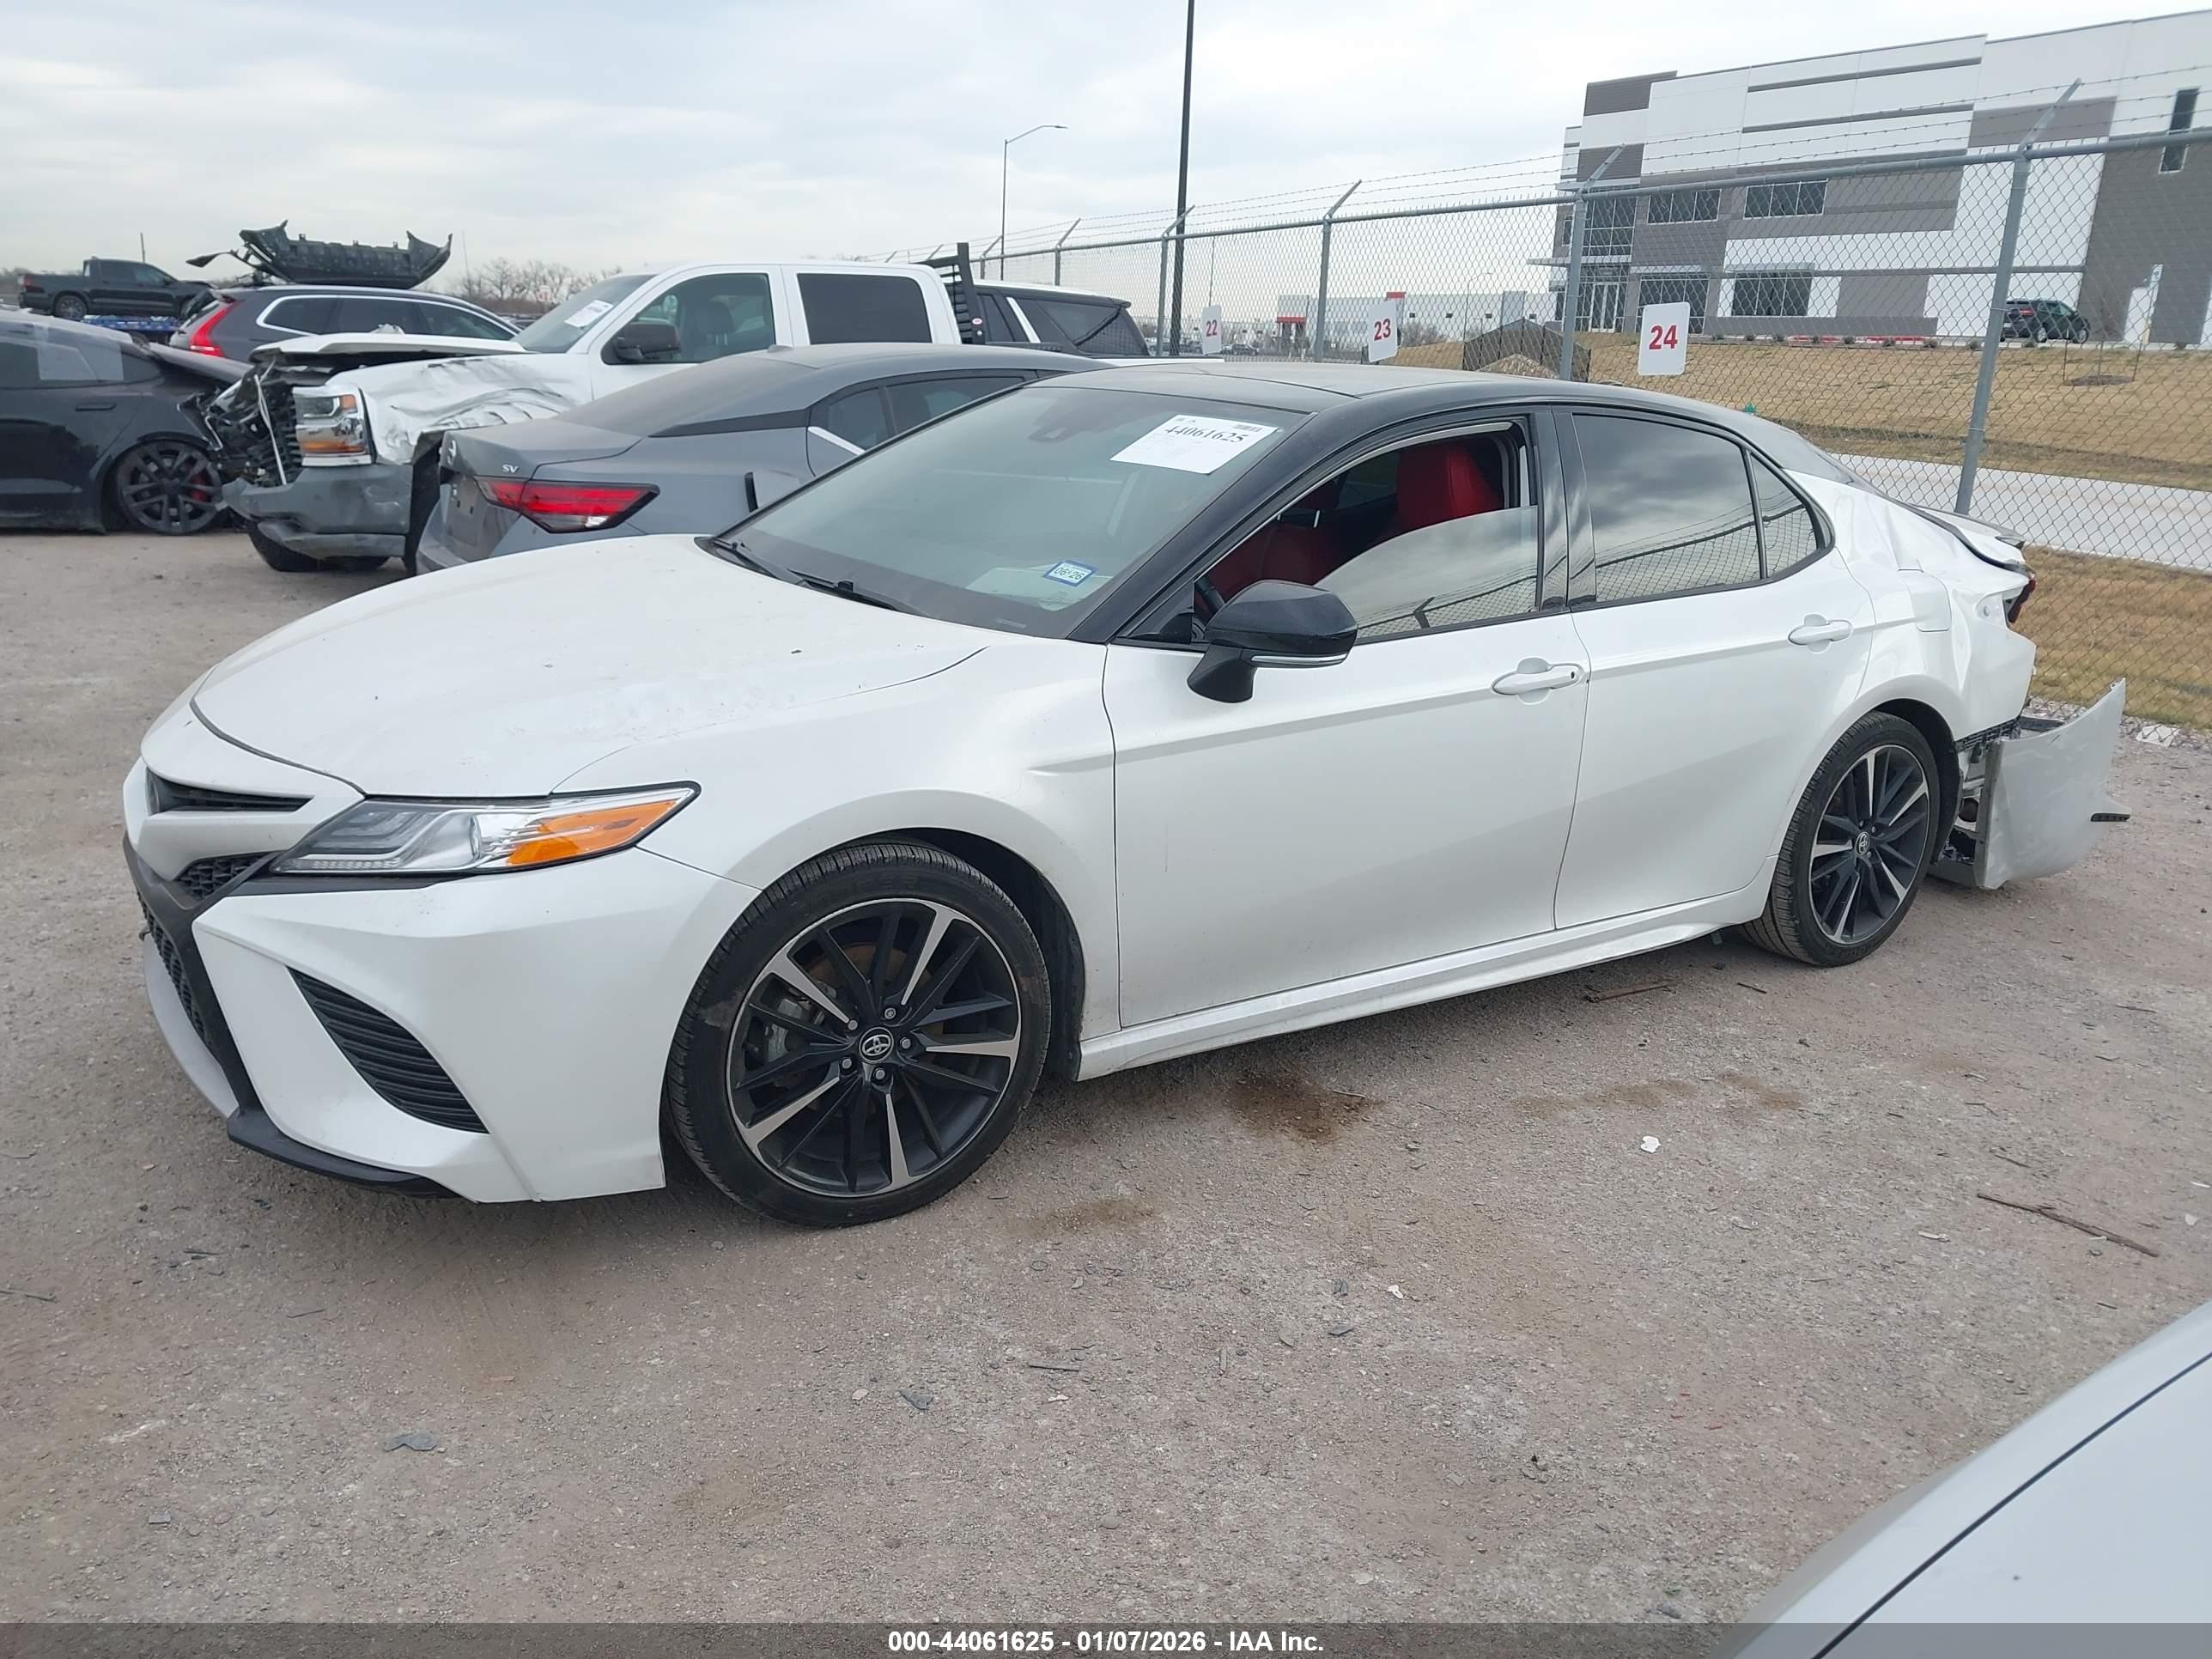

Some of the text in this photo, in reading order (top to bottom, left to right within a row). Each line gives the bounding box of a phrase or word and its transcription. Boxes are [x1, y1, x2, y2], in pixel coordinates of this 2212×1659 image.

[1206, 319, 1218, 337] 22
[1374, 318, 1391, 341] 23
[1649, 325, 1678, 349] 24
[1164, 426, 1249, 443] 44061625
[502, 464, 520, 473] SV
